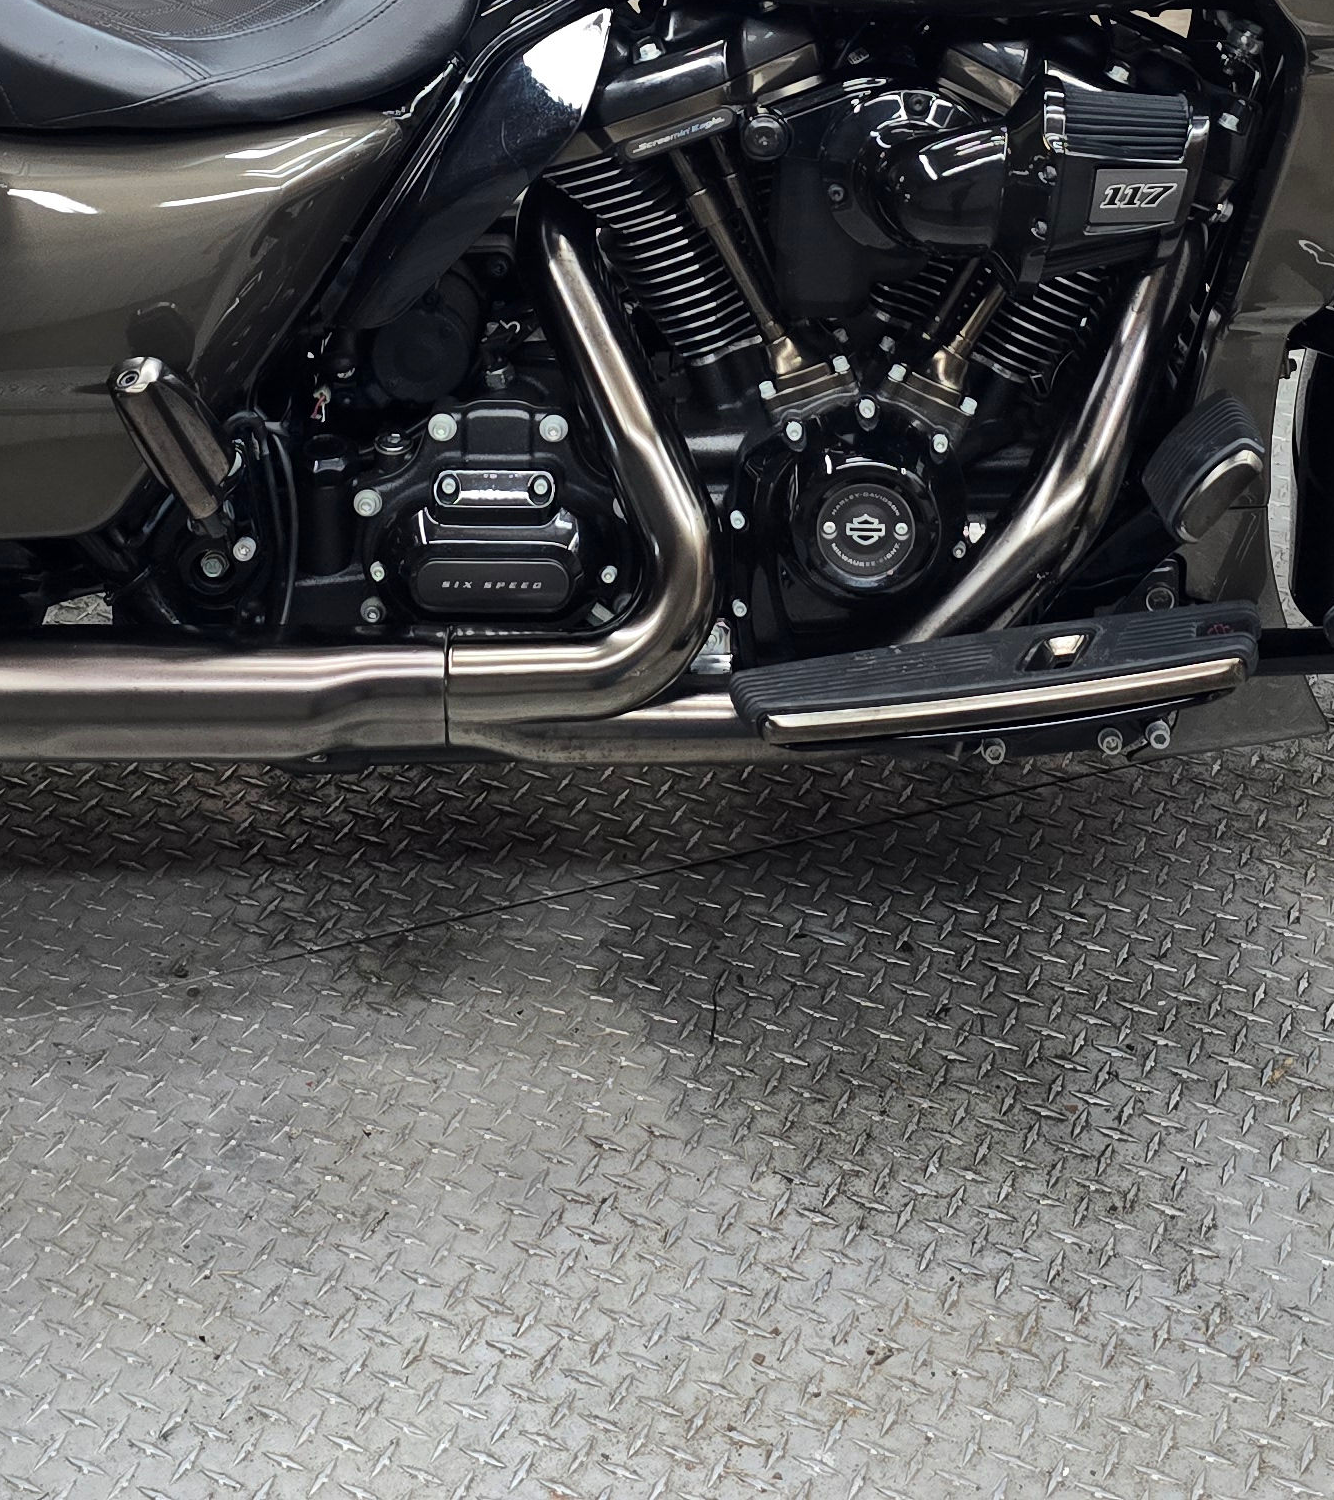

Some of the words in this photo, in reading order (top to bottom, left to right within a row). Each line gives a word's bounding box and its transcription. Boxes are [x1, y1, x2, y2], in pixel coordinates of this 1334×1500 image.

[1100, 183, 1178, 208] 117
[442, 581, 473, 589] SIX
[483, 581, 542, 589] SPEED
